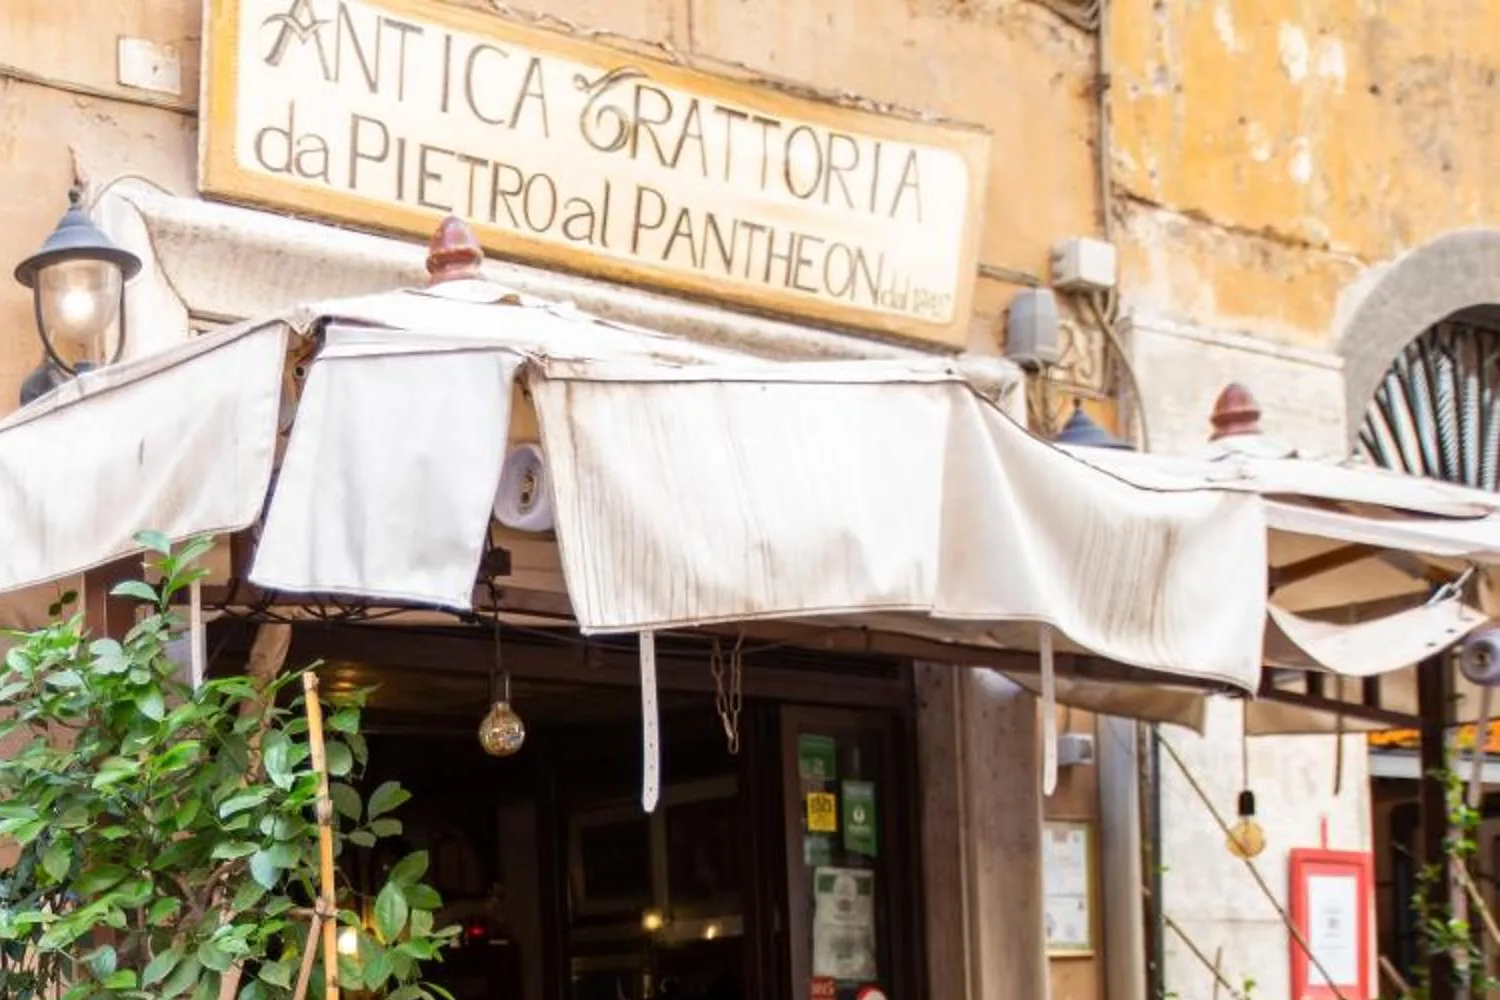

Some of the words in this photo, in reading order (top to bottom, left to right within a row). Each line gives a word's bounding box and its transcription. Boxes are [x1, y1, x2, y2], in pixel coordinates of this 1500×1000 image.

[254, 100, 331, 185] da
[347, 113, 557, 233] PIETRO
[561, 179, 611, 249] al
[631, 184, 885, 306] PANTHEON
[261, 0, 550, 138] ANTICA
[573, 65, 923, 225] TRATTORIA
